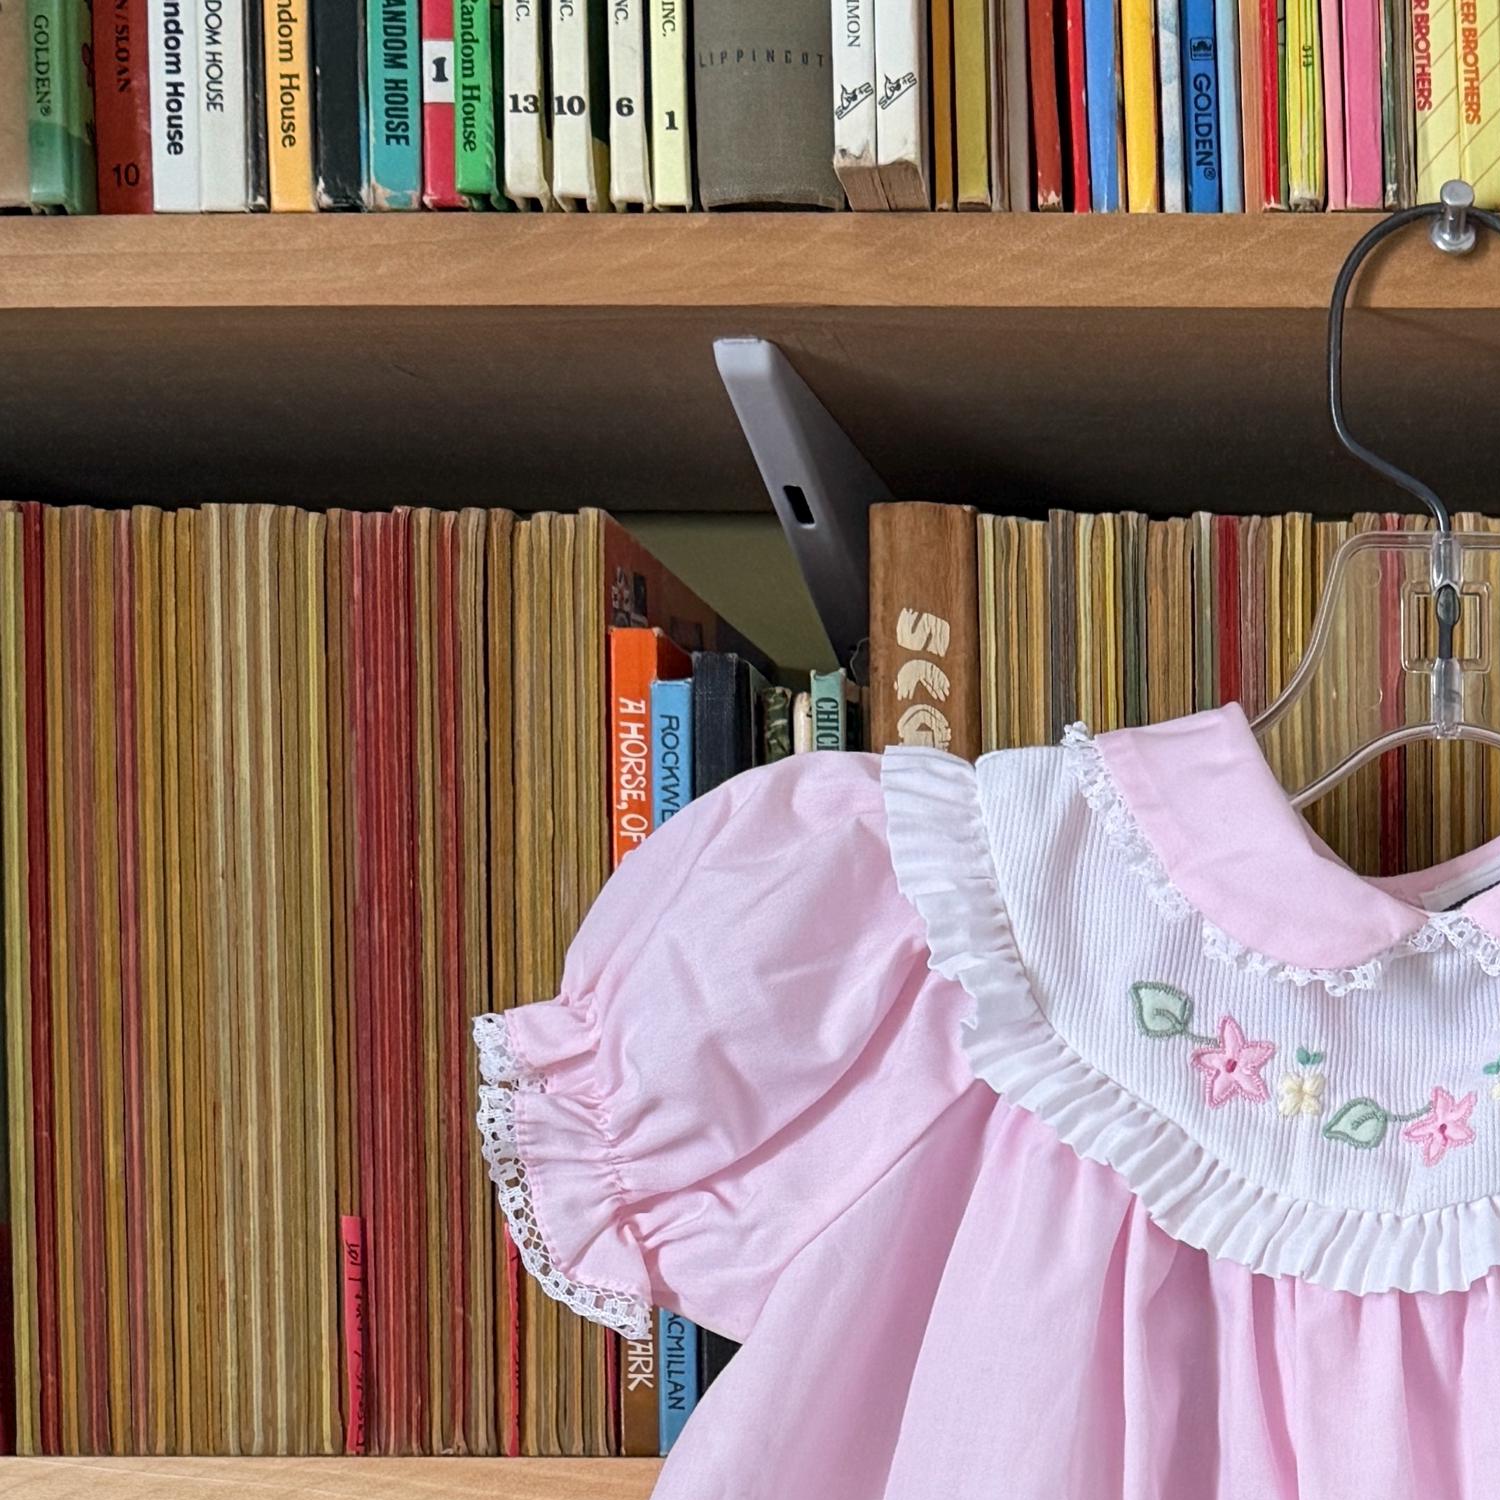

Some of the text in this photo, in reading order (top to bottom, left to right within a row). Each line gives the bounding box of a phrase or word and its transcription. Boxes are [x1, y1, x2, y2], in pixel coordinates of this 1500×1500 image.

[206, 51, 225, 113] HOUSE
[432, 56, 449, 82] 1
[1414, 12, 1432, 111] BROTHERS
[1461, 27, 1481, 125] BROTHERS
[165, 82, 184, 156] House
[279, 72, 301, 148] House
[384, 79, 410, 146] HOUSE
[462, 85, 481, 153] House
[509, 94, 539, 113] 13
[554, 95, 585, 115] 10
[615, 97, 635, 116] 6
[665, 111, 678, 130] 1
[112, 164, 140, 187] 10
[619, 697, 646, 714] A
[616, 721, 648, 810] HORSE,
